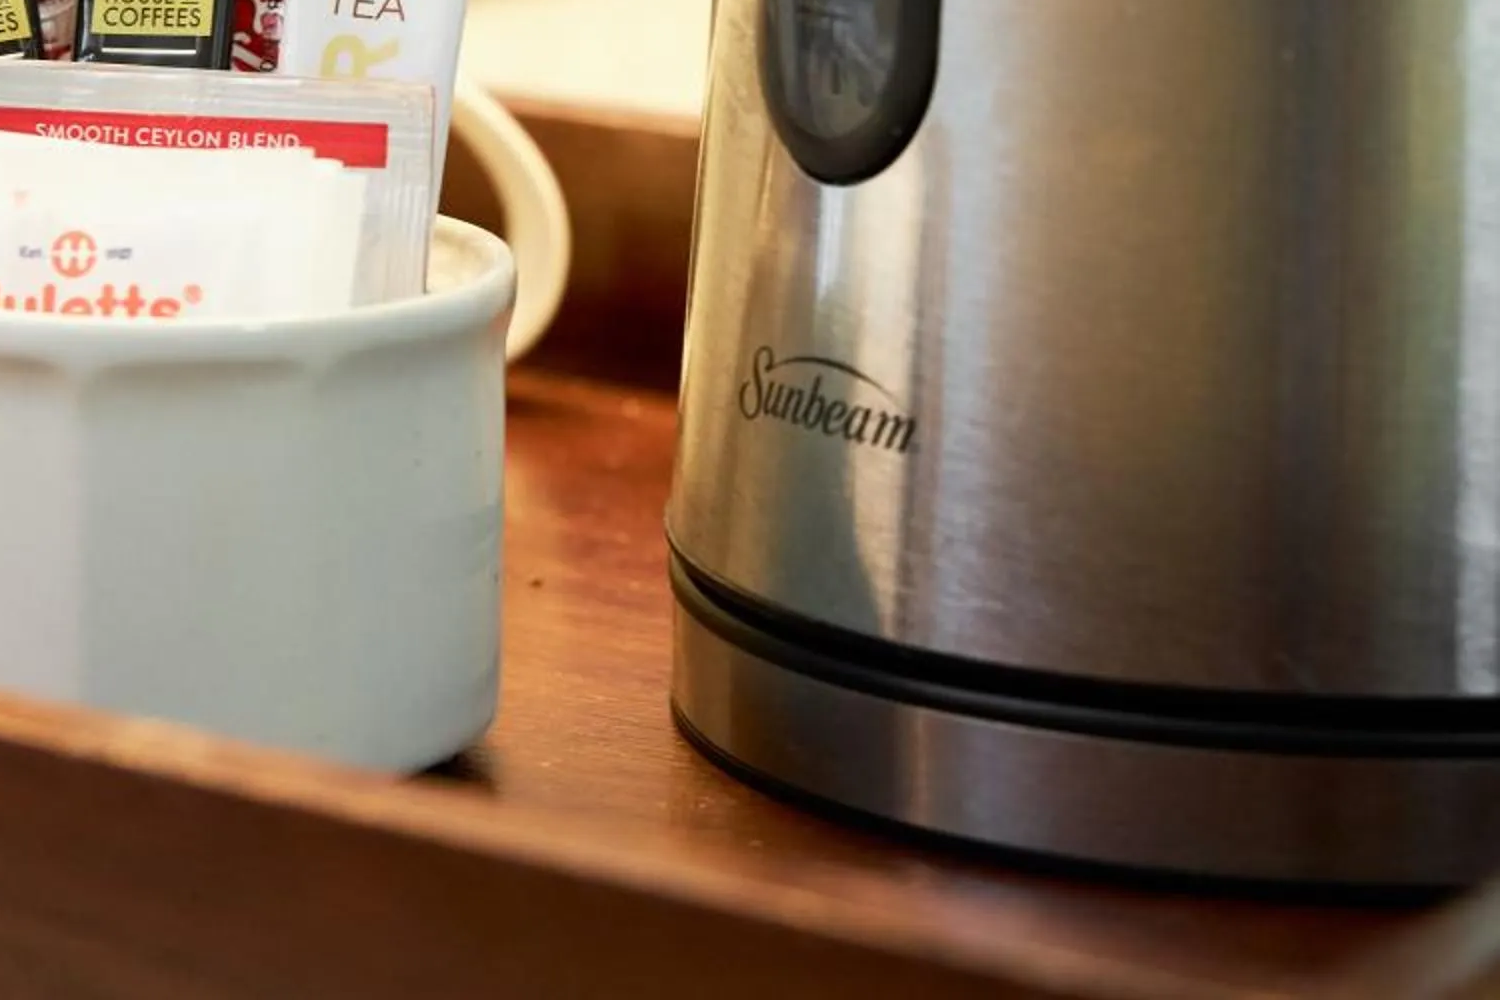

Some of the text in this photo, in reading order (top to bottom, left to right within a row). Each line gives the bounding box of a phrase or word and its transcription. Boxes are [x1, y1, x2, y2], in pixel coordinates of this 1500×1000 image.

[103, 6, 201, 27] COFFEES
[35, 122, 299, 149] SMOOTH CEYLON BLEND
[739, 346, 916, 454] Sunbeam
